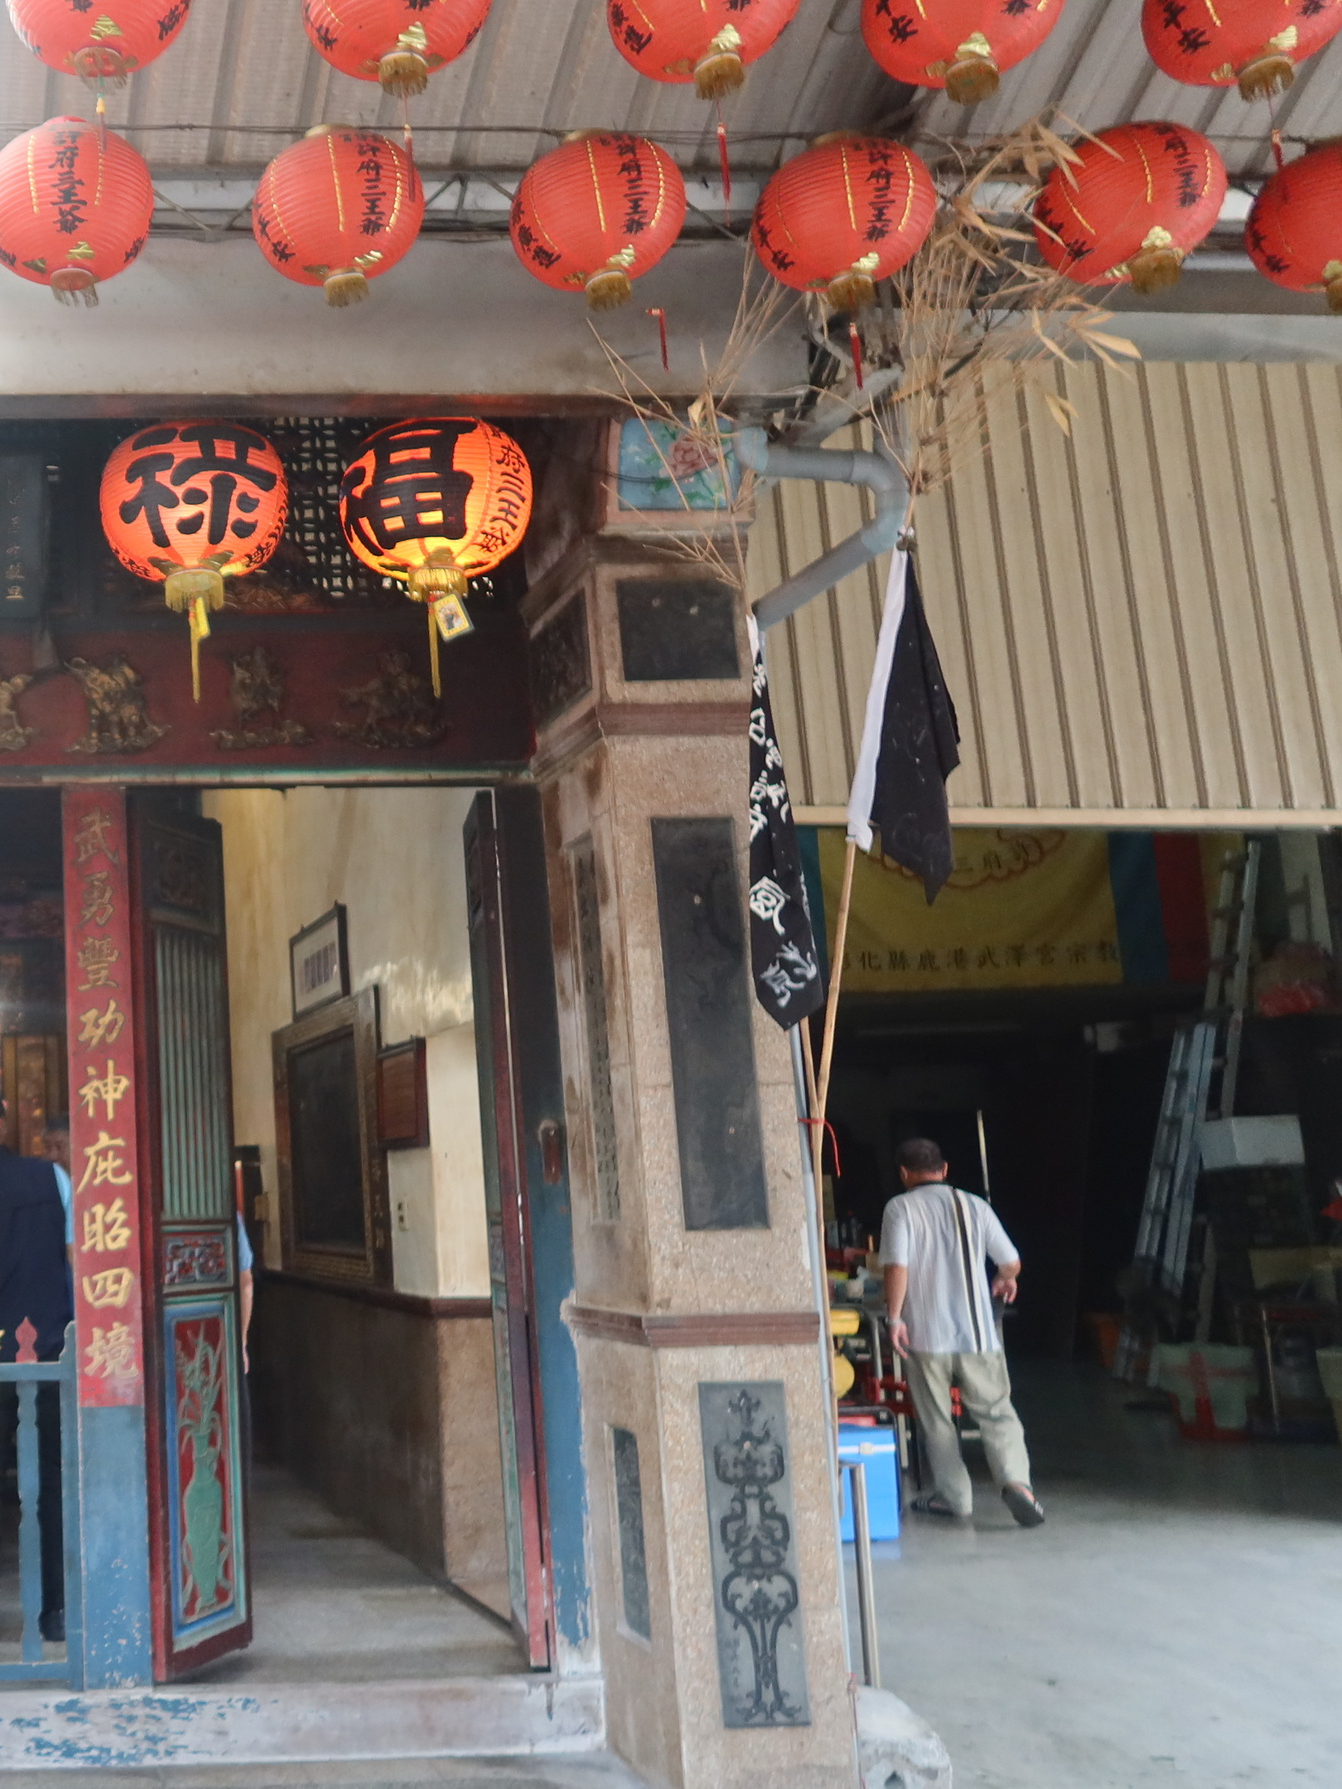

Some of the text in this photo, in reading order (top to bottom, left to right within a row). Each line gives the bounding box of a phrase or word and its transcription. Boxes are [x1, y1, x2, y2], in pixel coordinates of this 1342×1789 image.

[356, 142, 387, 236] 許府三王爺
[863, 149, 896, 242] 許府三王爺
[118, 425, 278, 549] 祿
[340, 421, 475, 557] 福
